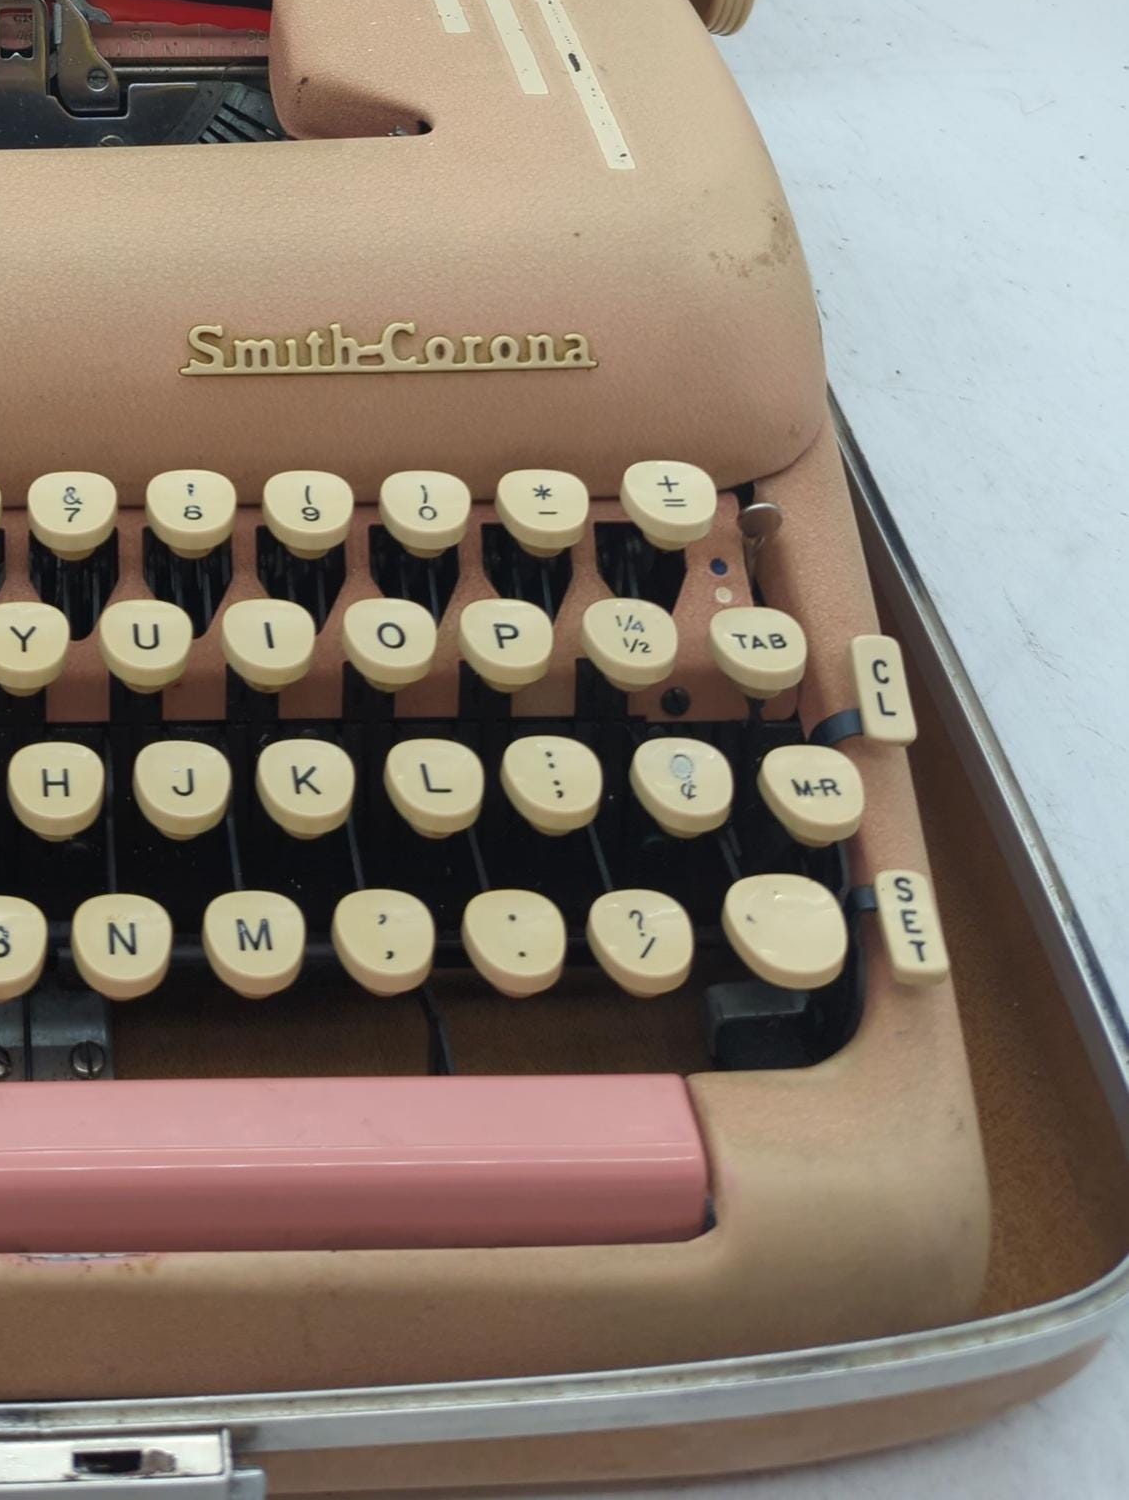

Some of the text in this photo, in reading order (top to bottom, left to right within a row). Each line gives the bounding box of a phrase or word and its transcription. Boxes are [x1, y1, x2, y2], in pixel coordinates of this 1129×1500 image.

[178, 321, 599, 376] Smith-Corona
[656, 475, 679, 493] +
[63, 507, 82, 524] 7
[301, 506, 321, 522] 9
[9, 625, 37, 653] Y
[132, 623, 160, 651] U
[376, 622, 407, 650] O
[493, 623, 520, 650] P
[731, 633, 788, 650] TAB
[41, 768, 70, 798] H
[171, 768, 195, 797] J
[291, 765, 322, 796] K
[419, 763, 453, 794] L
[790, 778, 842, 797] M-R
[235, 918, 274, 952] M
[628, 909, 648, 938] ?
[107, 922, 138, 956] N
